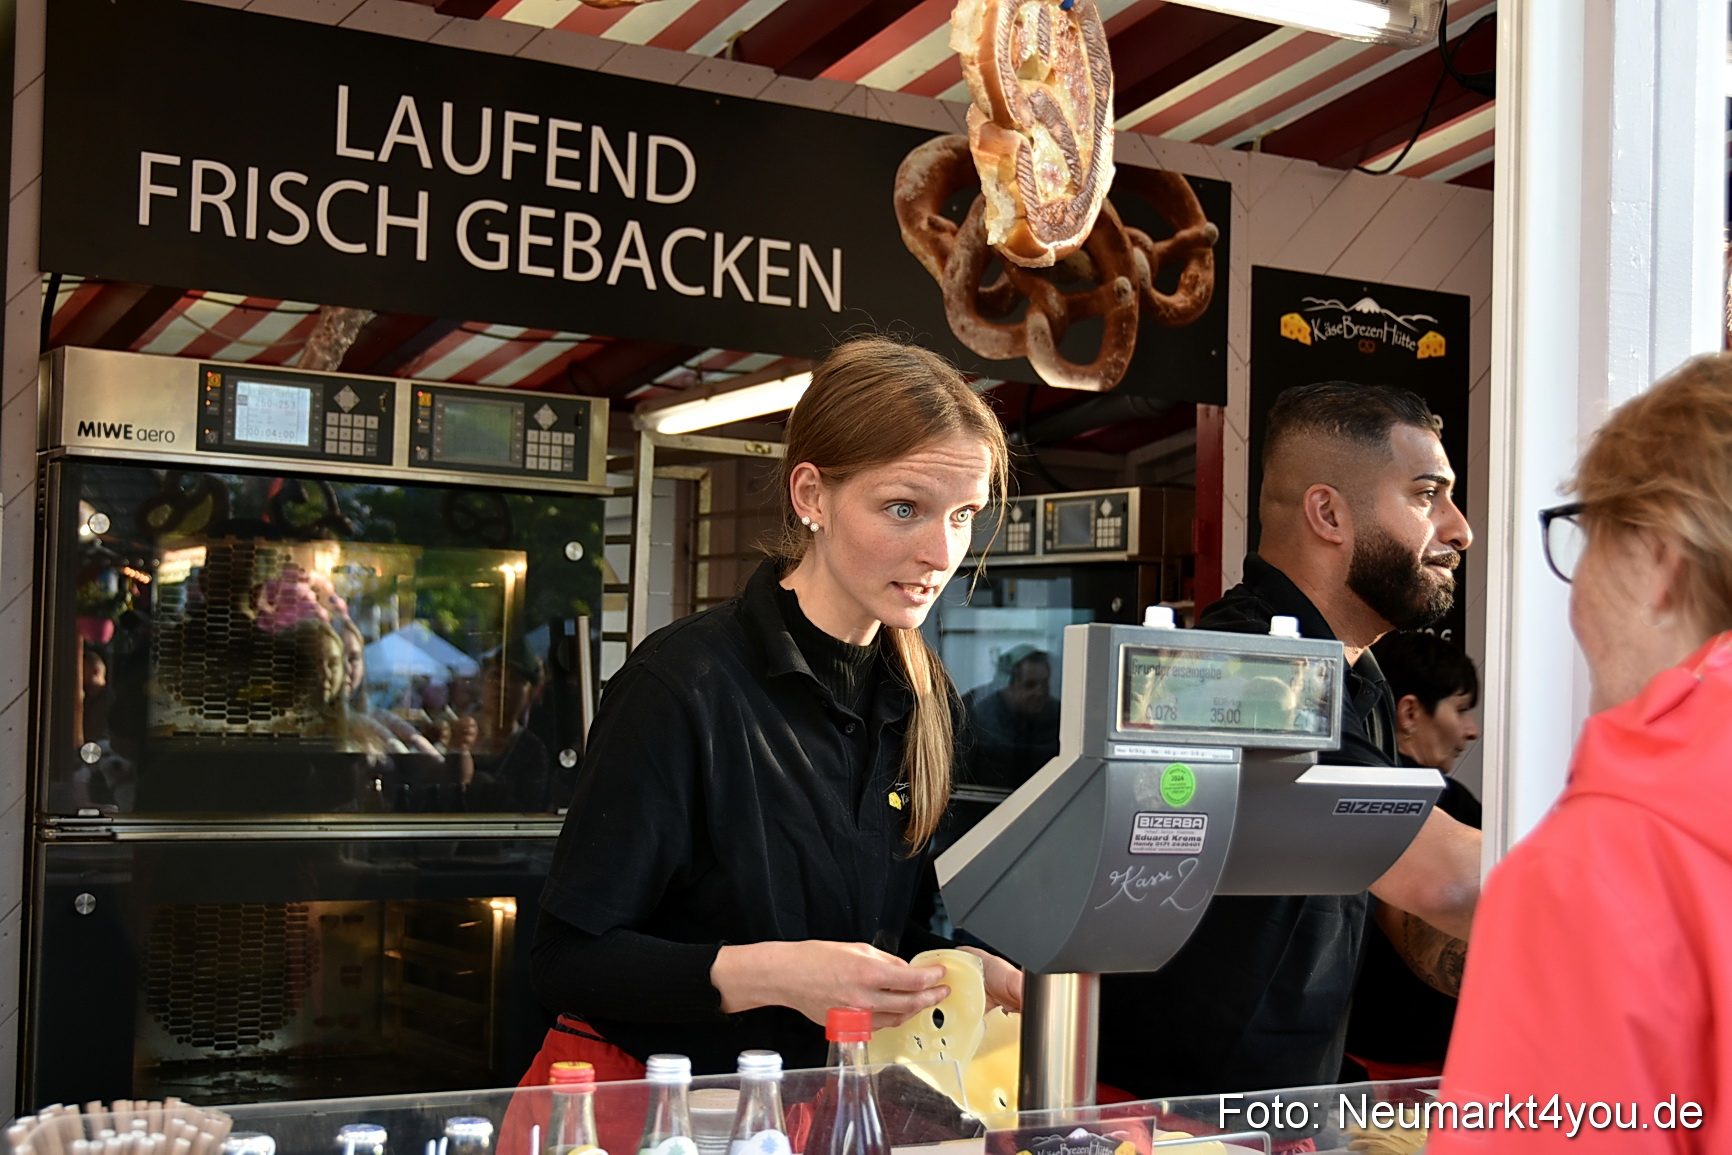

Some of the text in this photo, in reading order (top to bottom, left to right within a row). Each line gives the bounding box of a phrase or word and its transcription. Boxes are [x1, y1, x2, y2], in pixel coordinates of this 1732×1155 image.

[337, 84, 696, 204] LAUFEND
[138, 151, 843, 313] FRISCH GEBACKEN
[1311, 314, 1417, 351] KäseBrezenHütte
[77, 420, 176, 443] MIWE aero
[1131, 658, 1222, 682] Grundpreiseingabe
[1334, 801, 1424, 814] BIZERBA
[1139, 817, 1203, 828] BIZERBA
[1135, 833, 1169, 841] Eduard
